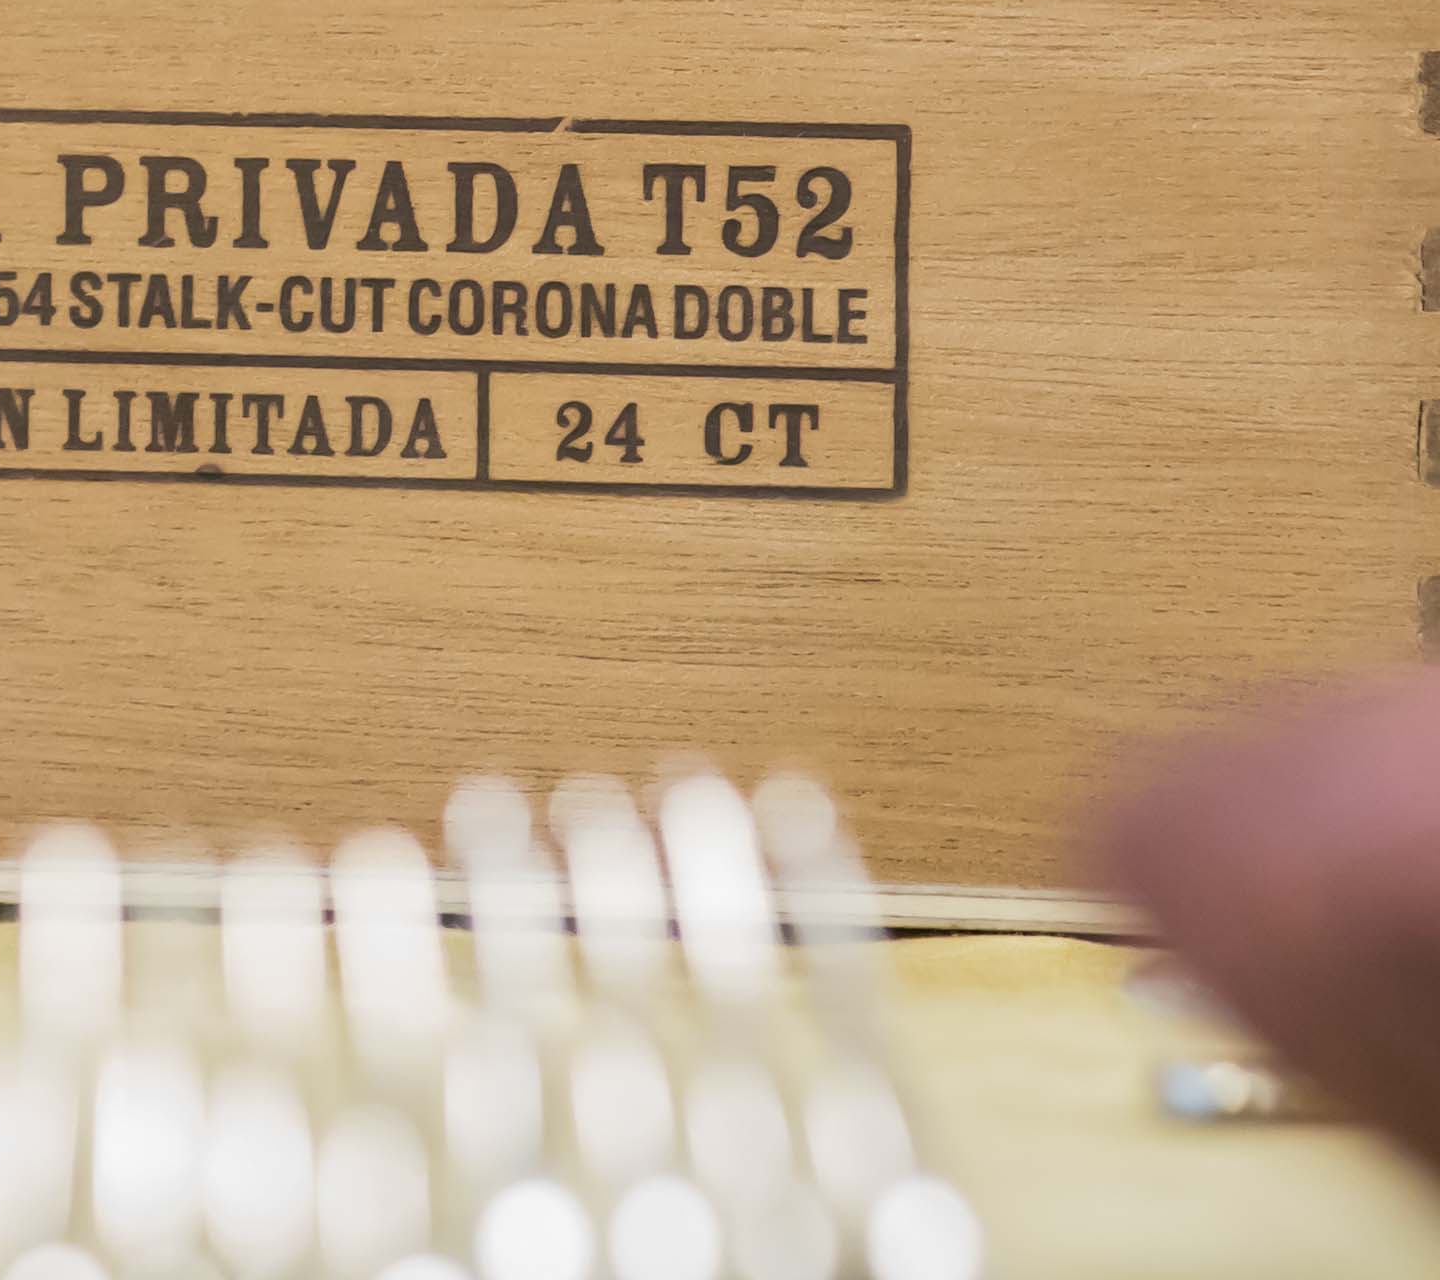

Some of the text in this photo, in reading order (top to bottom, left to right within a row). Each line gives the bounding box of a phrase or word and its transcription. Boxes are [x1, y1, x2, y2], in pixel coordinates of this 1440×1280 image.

[54, 152, 607, 258] PRIVADA
[641, 161, 855, 262] T52
[67, 270, 398, 335] STALK-CUT
[406, 277, 661, 340] CORONA
[672, 283, 870, 346] DOBLE
[61, 388, 449, 461] LIMITADA
[554, 399, 821, 469] 24 CT
